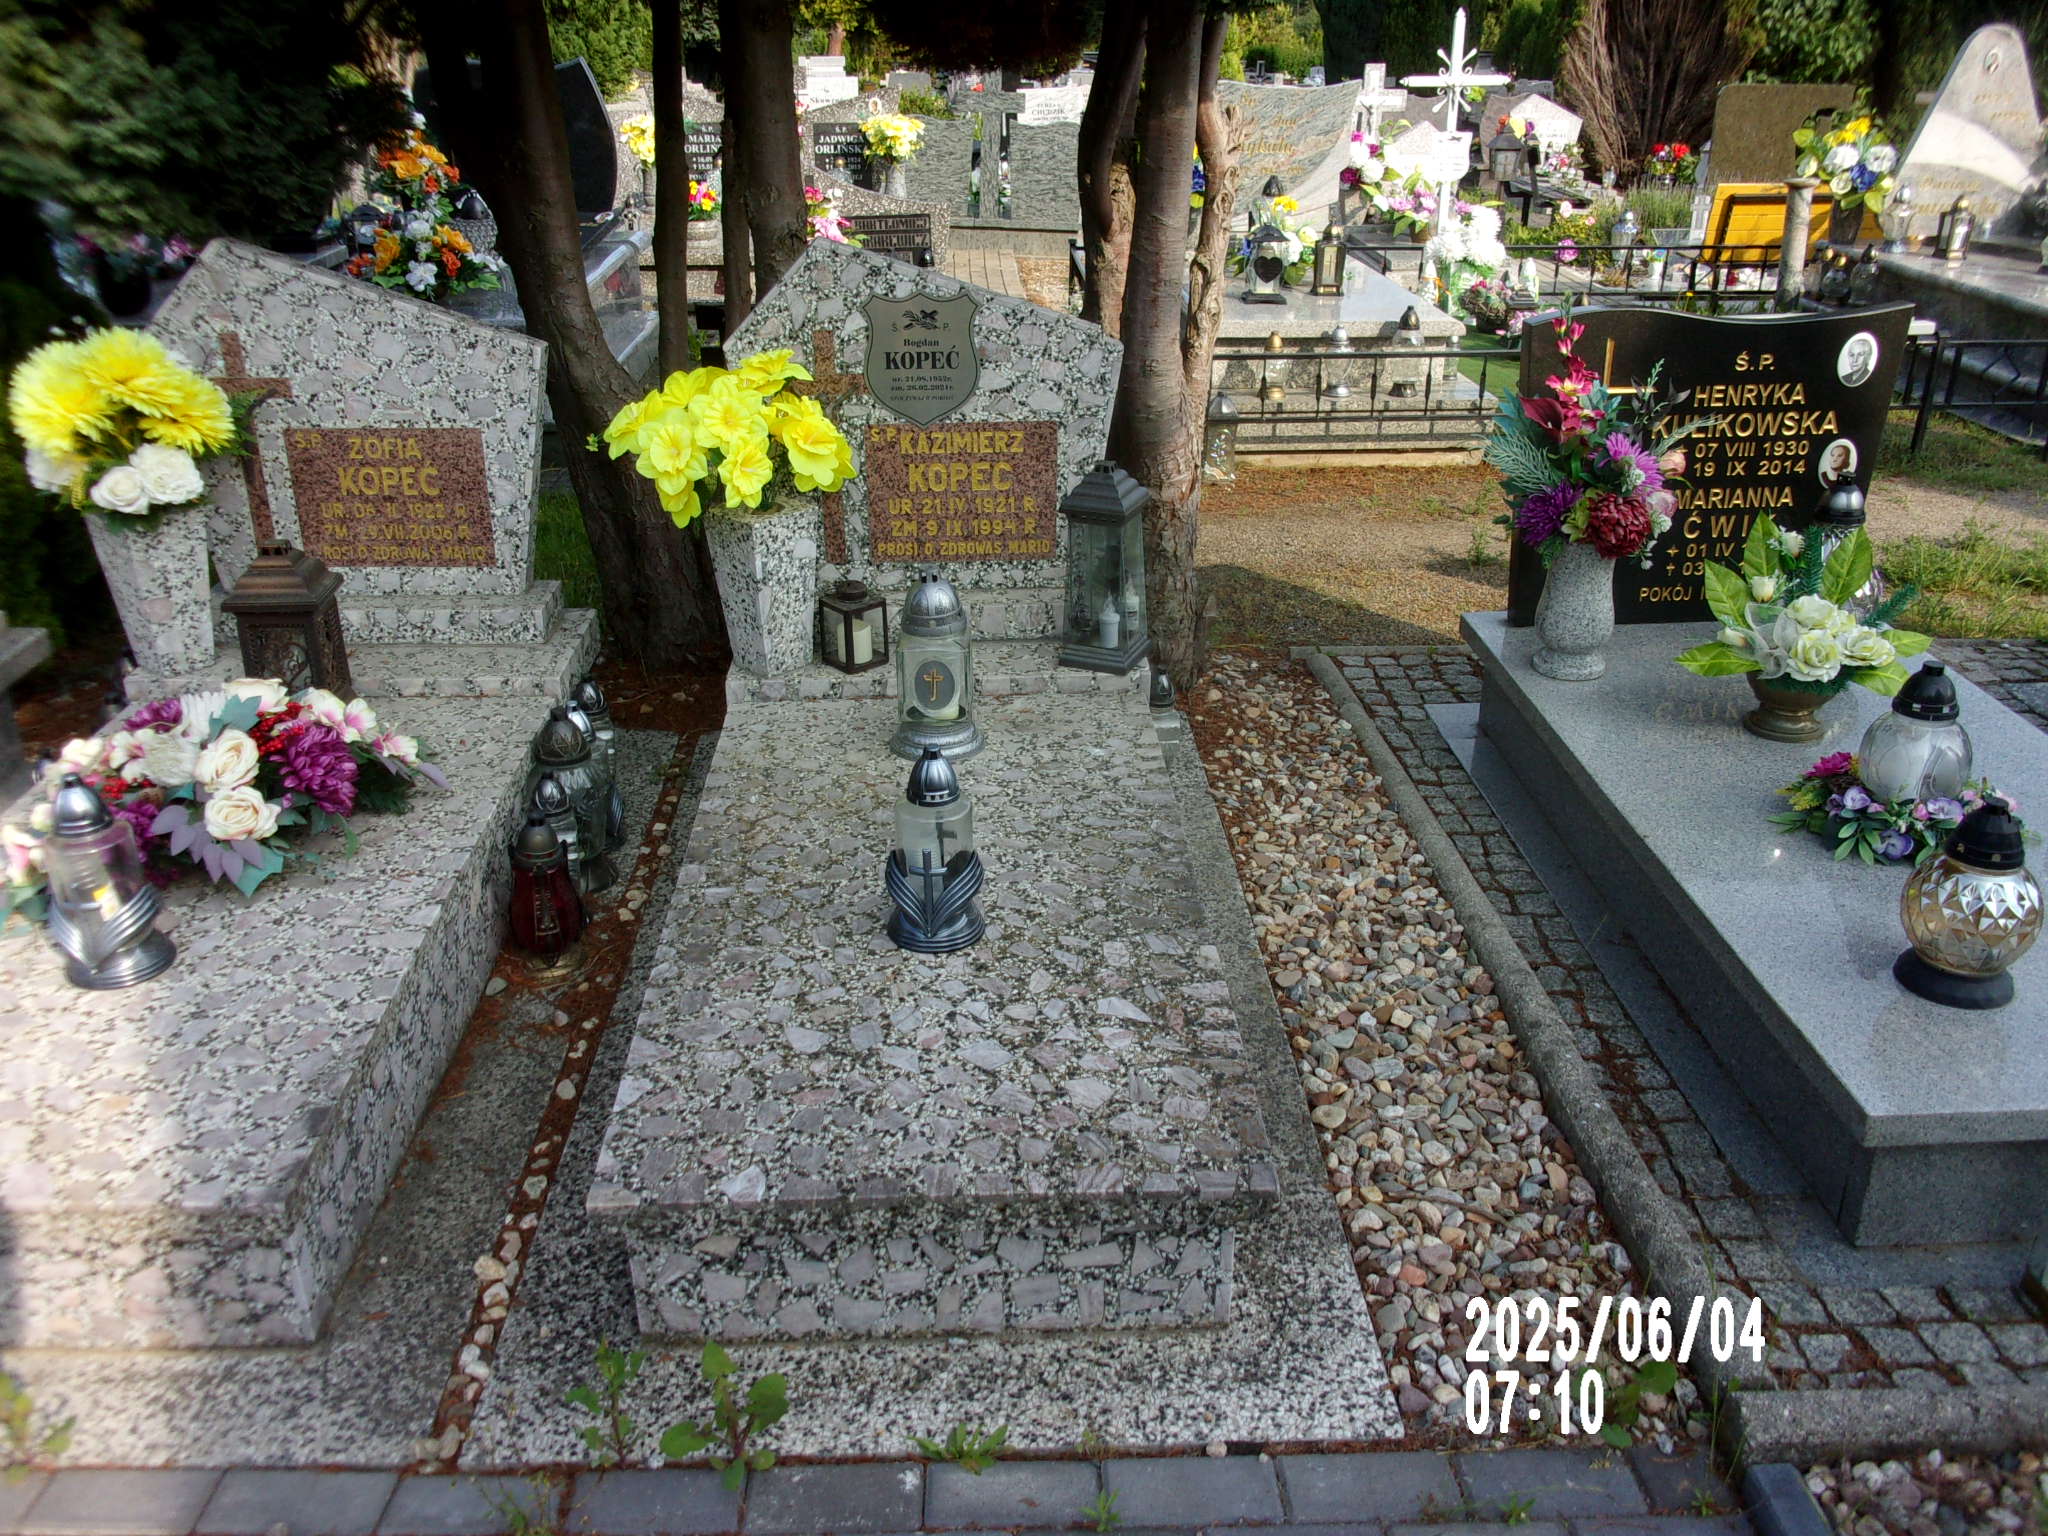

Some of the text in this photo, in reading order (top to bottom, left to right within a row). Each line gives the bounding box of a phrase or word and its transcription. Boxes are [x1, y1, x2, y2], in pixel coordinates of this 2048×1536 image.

[688, 134, 722, 143] MARIA
[818, 135, 865, 144] JADWIGA
[684, 142, 722, 154] ORLIŃ
[815, 143, 863, 154] ORLIŃSK
[903, 339, 940, 348] Bogdan
[884, 345, 960, 370] KOPEĆ
[1693, 382, 1807, 408] HENRYKA
[347, 436, 423, 459] ZOFIA
[900, 430, 1025, 454] KAZIMIERZ
[1694, 440, 1811, 459] 07 VIII 1930
[1693, 459, 1807, 477] 19 IX 2014
[337, 461, 442, 496] KOPEĆ
[975, 495, 1016, 513] 1921
[1674, 486, 1794, 510] MARIANNA
[409, 502, 446, 519] 1922
[972, 518, 1017, 536] 1994
[1683, 510, 1751, 539] ĆWI
[1686, 543, 1709, 558] 01
[1714, 542, 1736, 557] IV
[1639, 583, 1693, 603] POKÓJ
